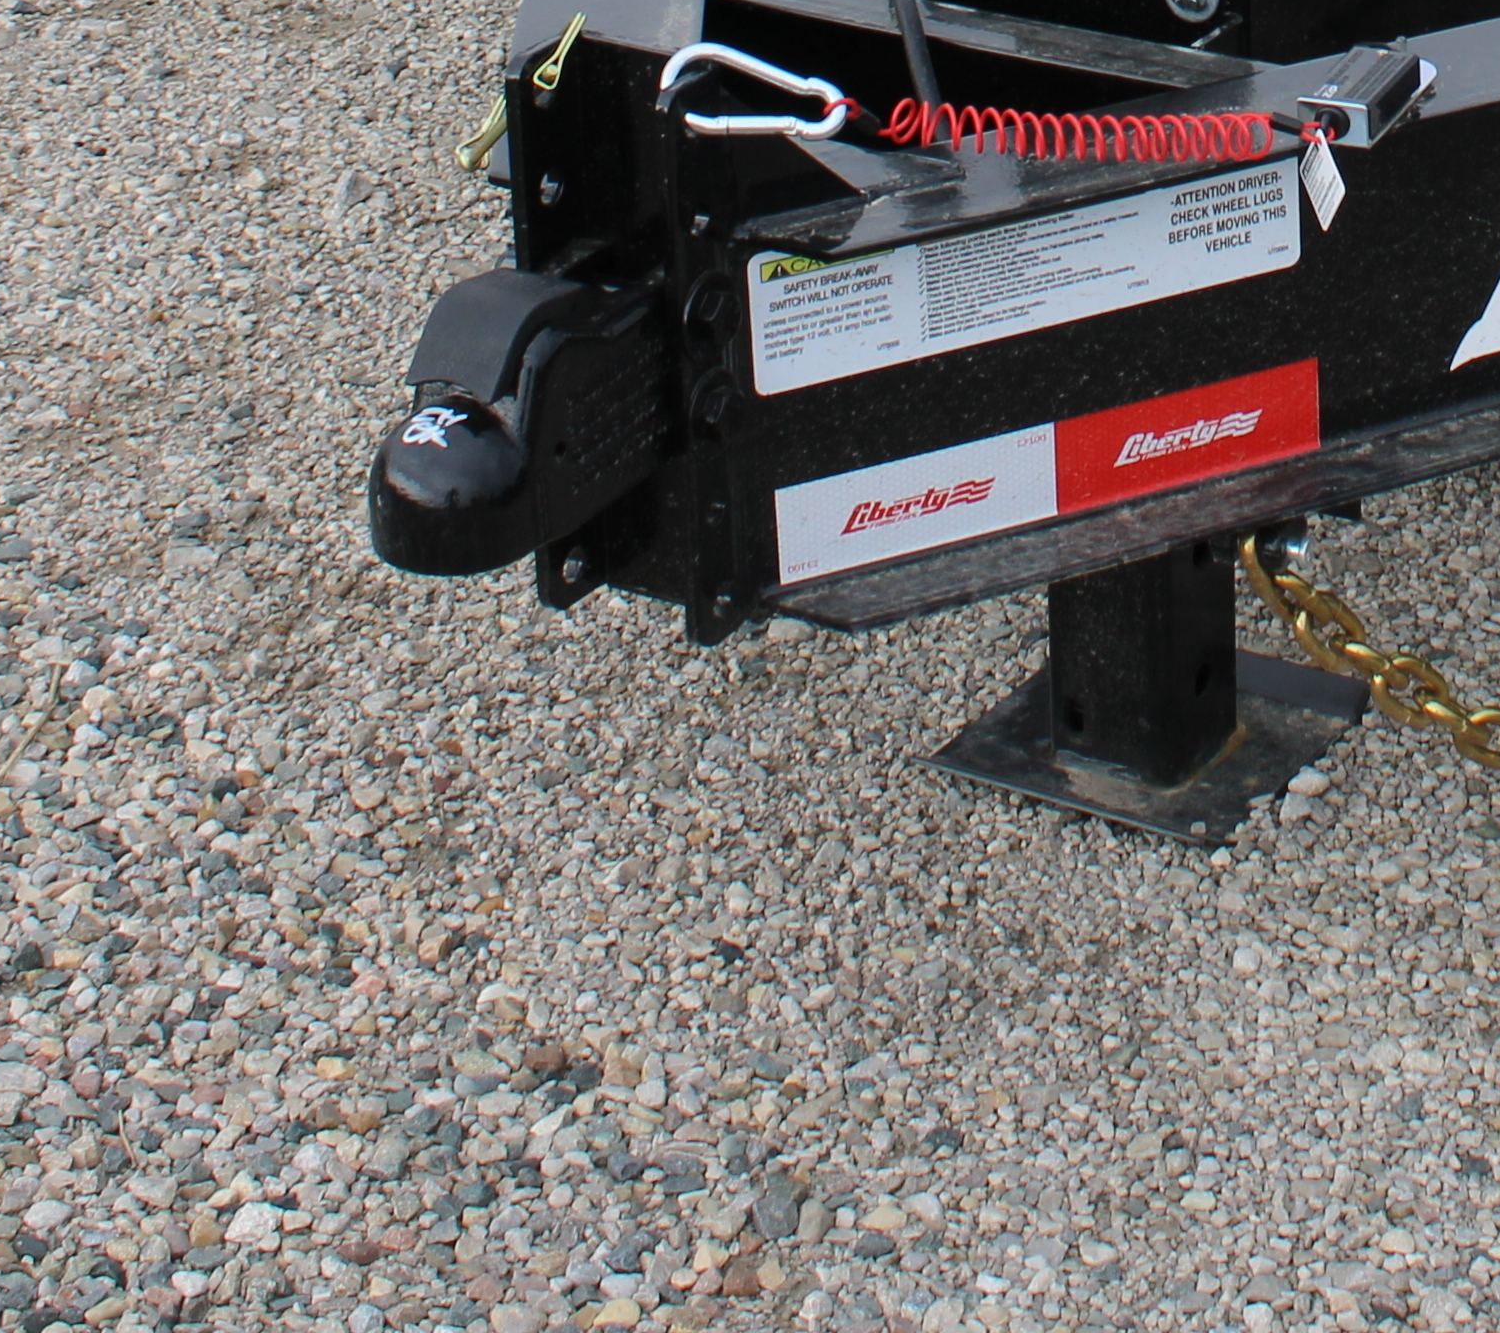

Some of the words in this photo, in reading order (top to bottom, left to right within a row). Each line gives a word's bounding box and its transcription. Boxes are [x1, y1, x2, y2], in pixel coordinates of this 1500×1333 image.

[1168, 222, 1214, 245] BEFORE
[1216, 211, 1260, 233] MOVING
[1263, 205, 1287, 221] THIS
[1170, 205, 1209, 227] CHECK
[1211, 196, 1251, 217] WHEEL
[1253, 188, 1284, 206] LUGS
[1205, 231, 1252, 254] VEHICLE
[769, 295, 806, 313] SWITCH
[807, 291, 829, 305] WILL
[830, 285, 850, 299] NOT
[851, 274, 894, 294] OPERATE
[783, 278, 818, 295] SAFETY
[1113, 419, 1221, 469] Liberty
[840, 487, 953, 537] Liberty
